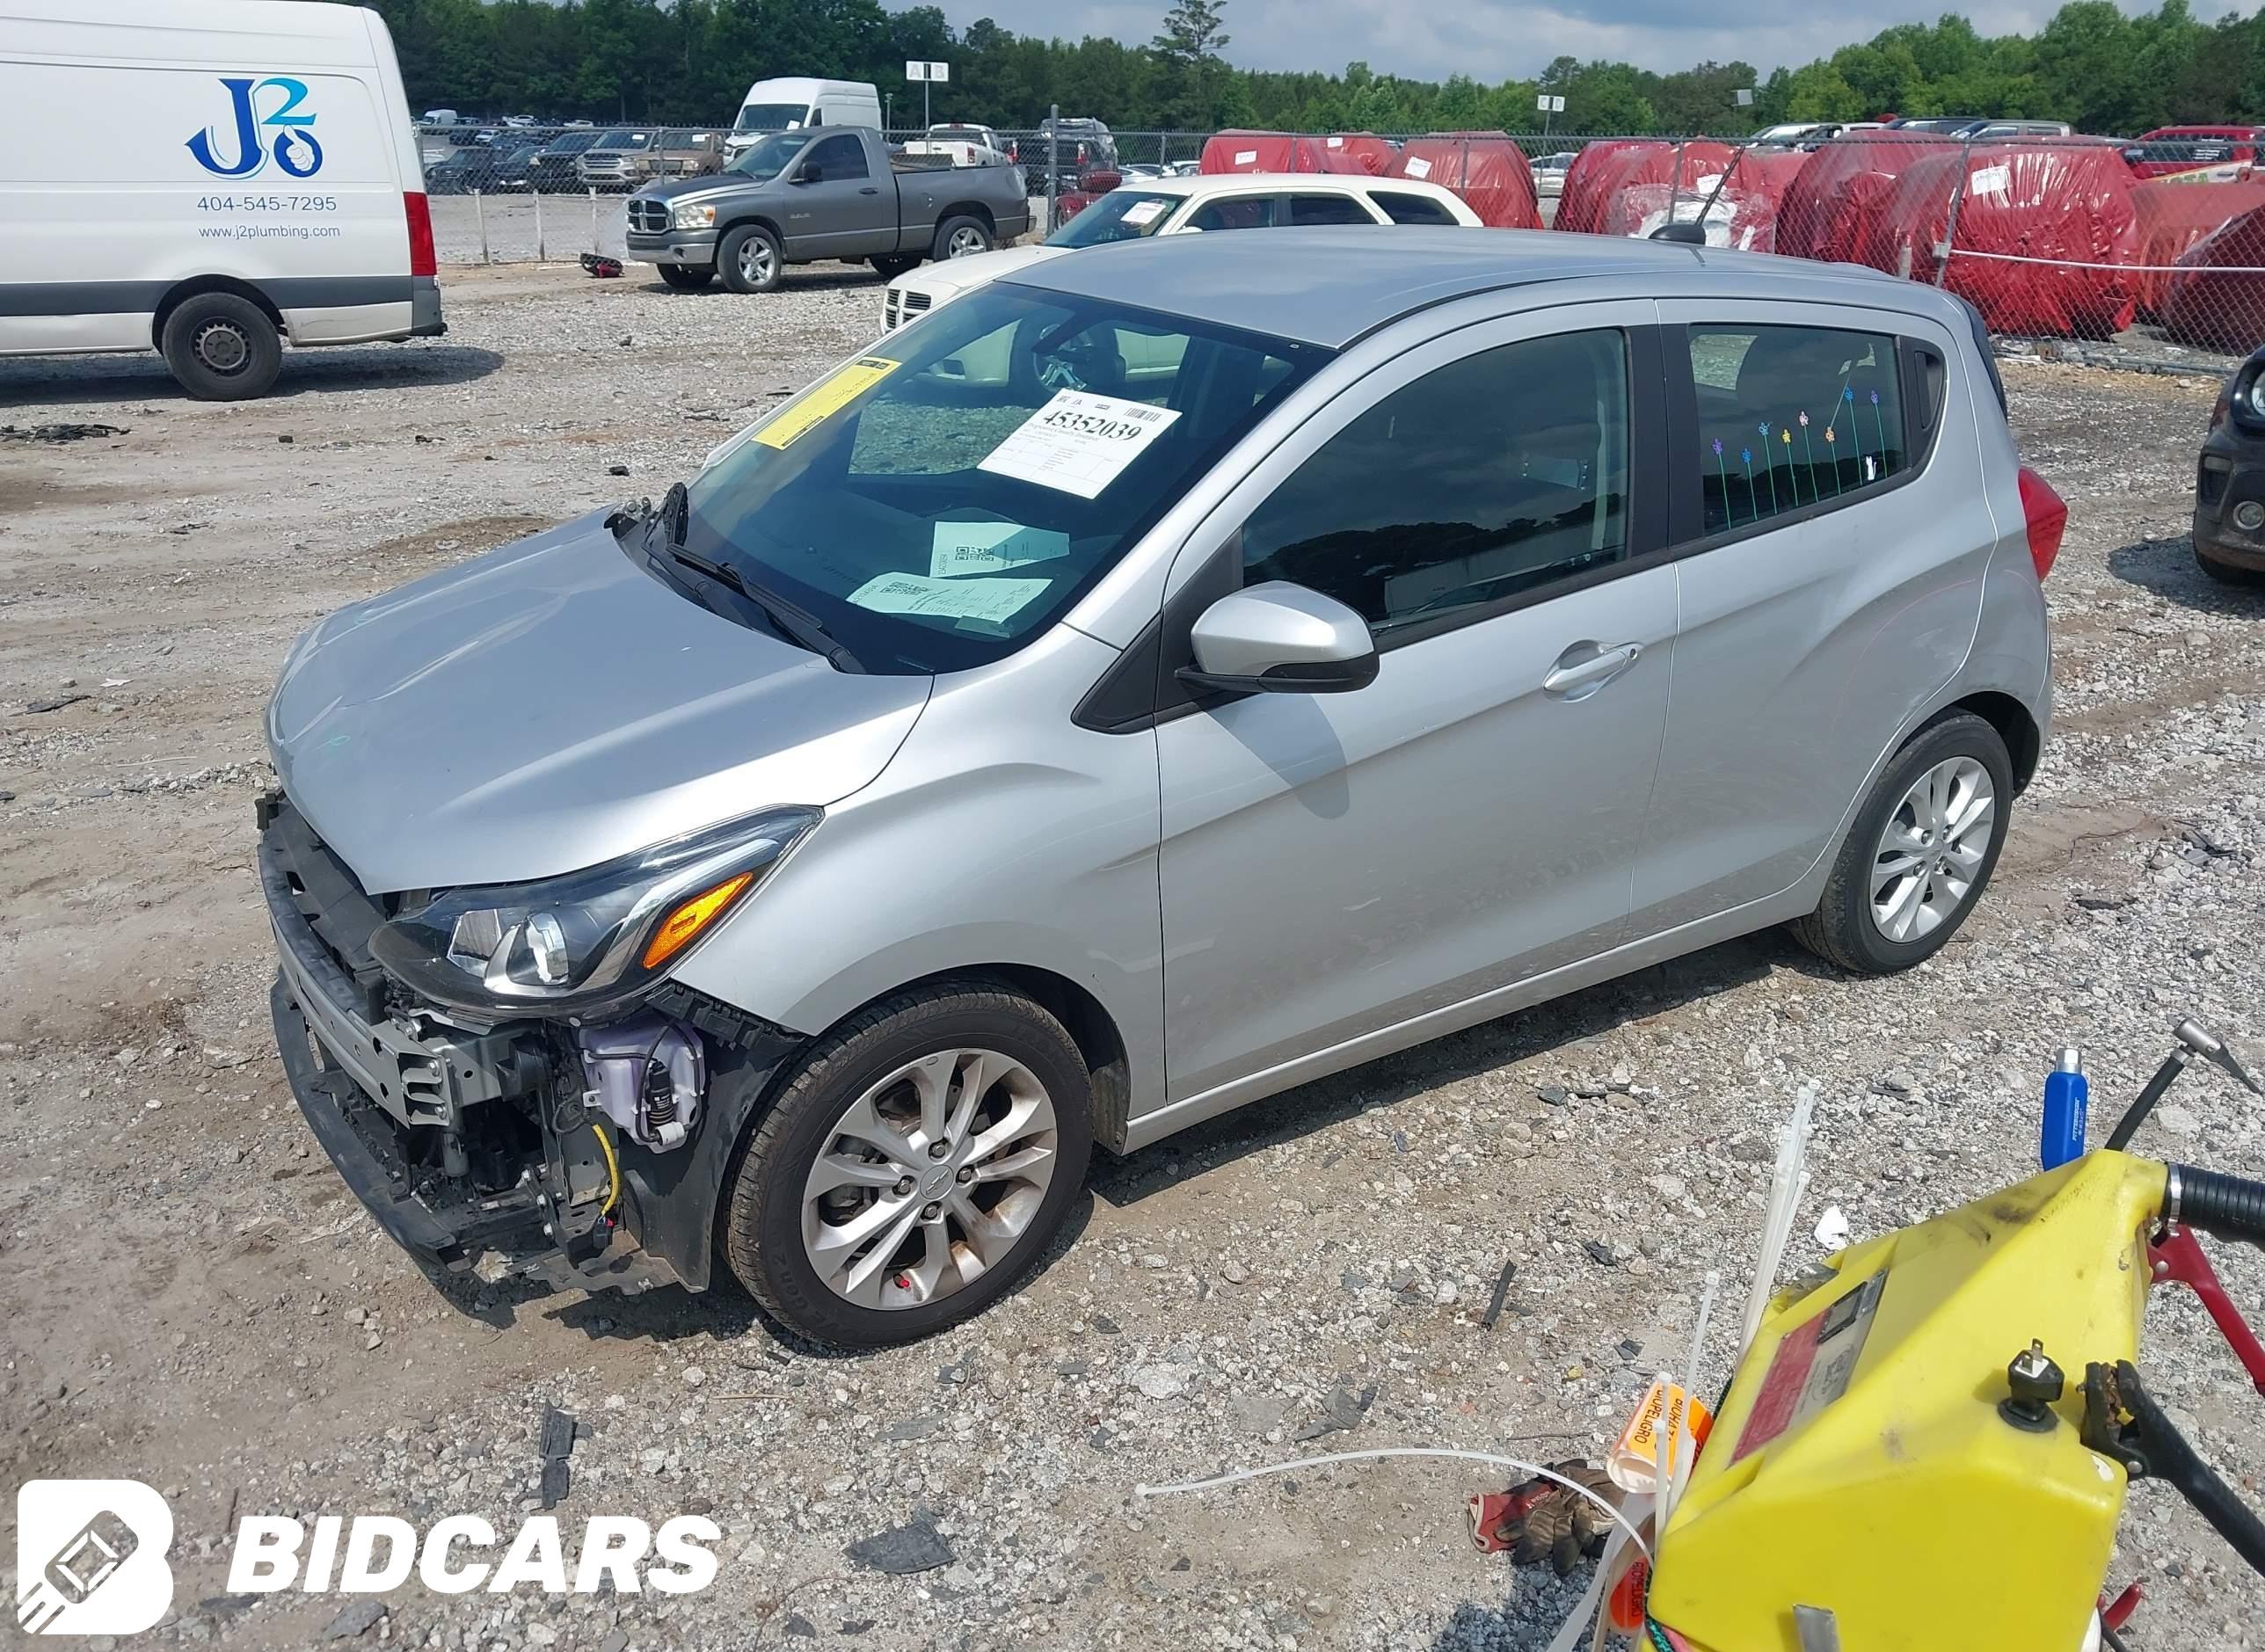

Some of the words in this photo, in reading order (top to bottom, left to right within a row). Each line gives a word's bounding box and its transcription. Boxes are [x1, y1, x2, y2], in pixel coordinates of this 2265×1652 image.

[908, 63, 922, 78] A
[934, 64, 945, 78] B
[197, 196, 337, 211] 404-545-7295
[199, 225, 340, 239] www.j2plumbing.com
[1043, 410, 1142, 440] 45352039
[1631, 1561, 1644, 1617] BIOPELIGRO
